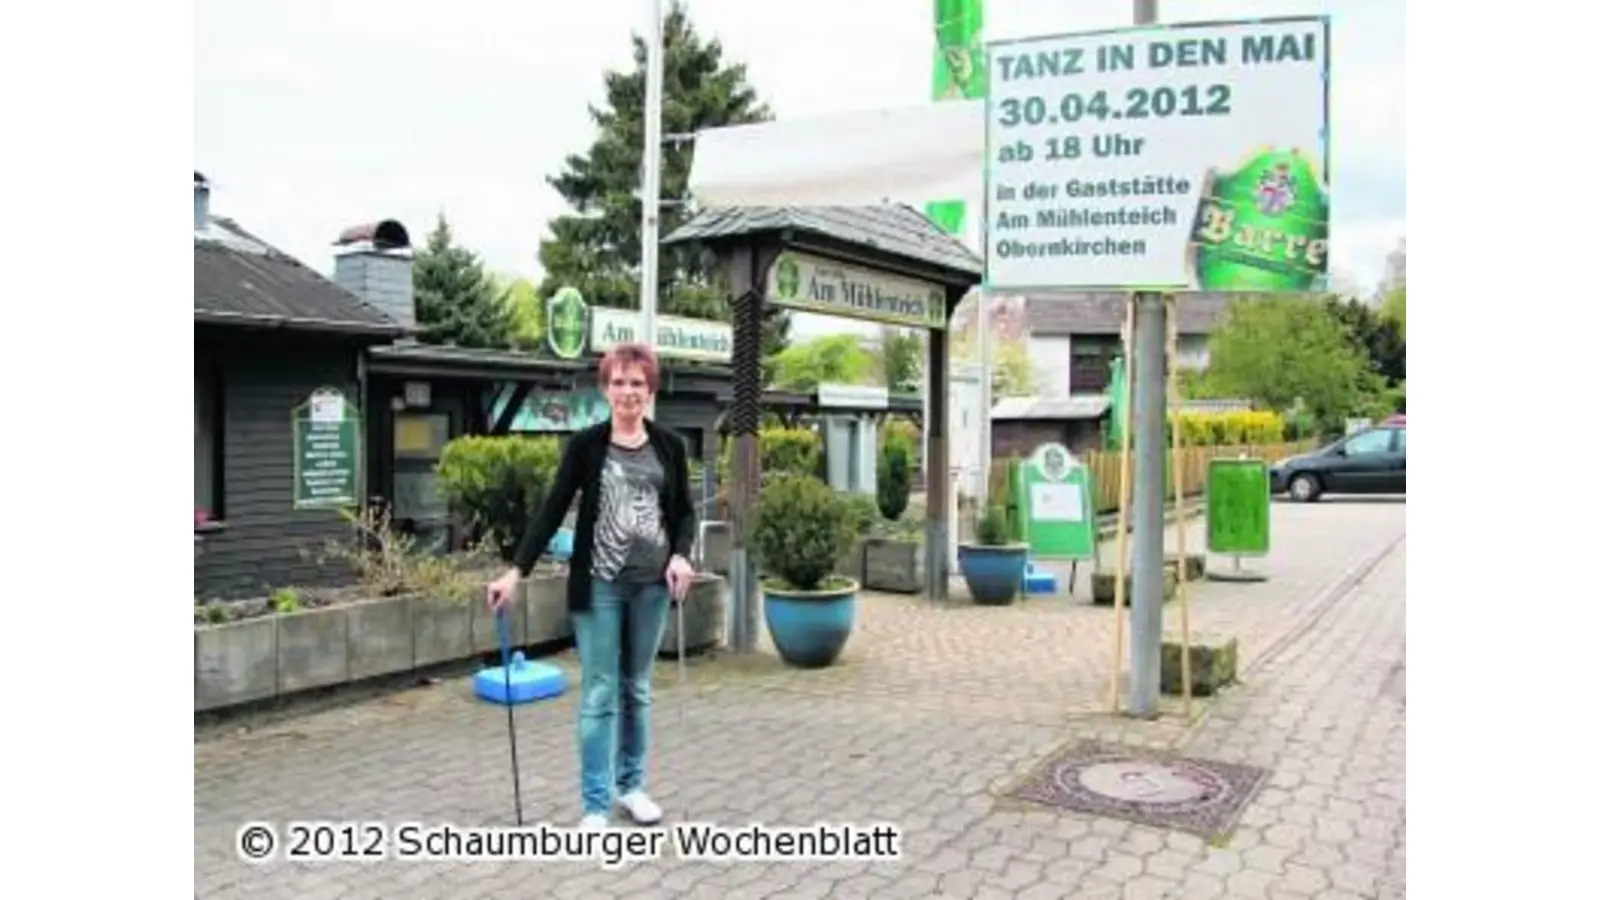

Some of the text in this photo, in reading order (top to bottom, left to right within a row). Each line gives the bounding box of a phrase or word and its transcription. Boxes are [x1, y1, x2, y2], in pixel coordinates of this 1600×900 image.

[997, 33, 1316, 81] TANZ IN DEN MAI
[998, 84, 1231, 127] 30.04.2012
[997, 134, 1145, 164] ab 18 Uhr
[1023, 181, 1058, 200] der
[1065, 175, 1191, 198] Gaststätte
[996, 204, 1177, 230] Am Mühlenteich
[1200, 201, 1326, 265] Barre
[808, 274, 836, 303] Am
[602, 320, 635, 343] Am
